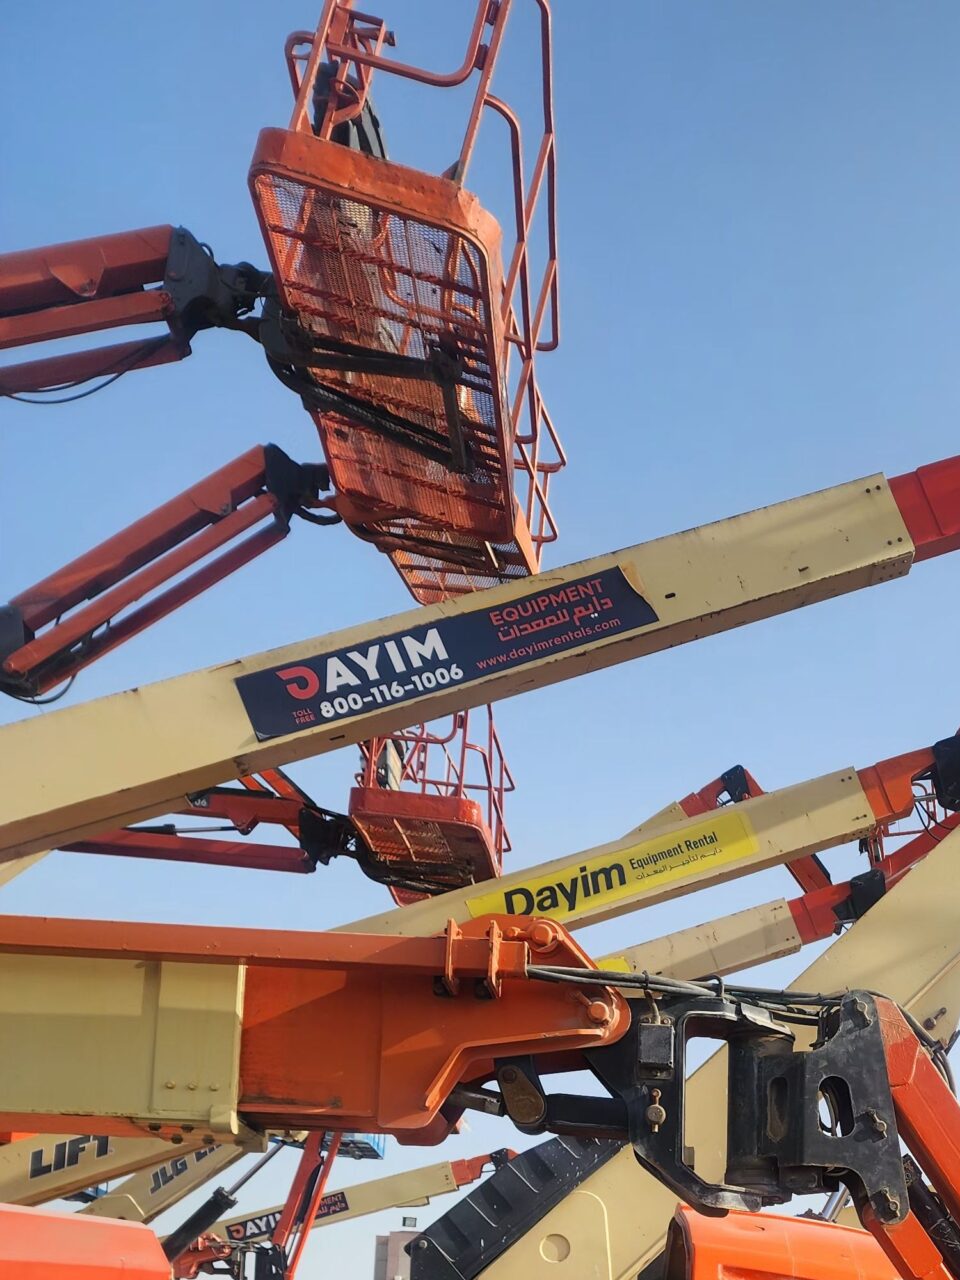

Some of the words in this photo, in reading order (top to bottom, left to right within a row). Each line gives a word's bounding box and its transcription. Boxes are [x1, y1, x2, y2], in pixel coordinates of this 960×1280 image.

[489, 578, 604, 626] EQUIPMENT
[274, 628, 449, 700] DAYIM
[476, 616, 622, 670] www.dayimrentals.com
[292, 708, 312, 718] TOLL
[319, 664, 464, 719] 800-116-1006
[295, 715, 316, 725] FREE
[629, 843, 684, 870] Equipment
[684, 831, 719, 852] Rental
[504, 862, 627, 916] Dayim
[29, 1135, 110, 1179] LIFT
[150, 1156, 188, 1194] JLG
[229, 1212, 283, 1240] DAYI
